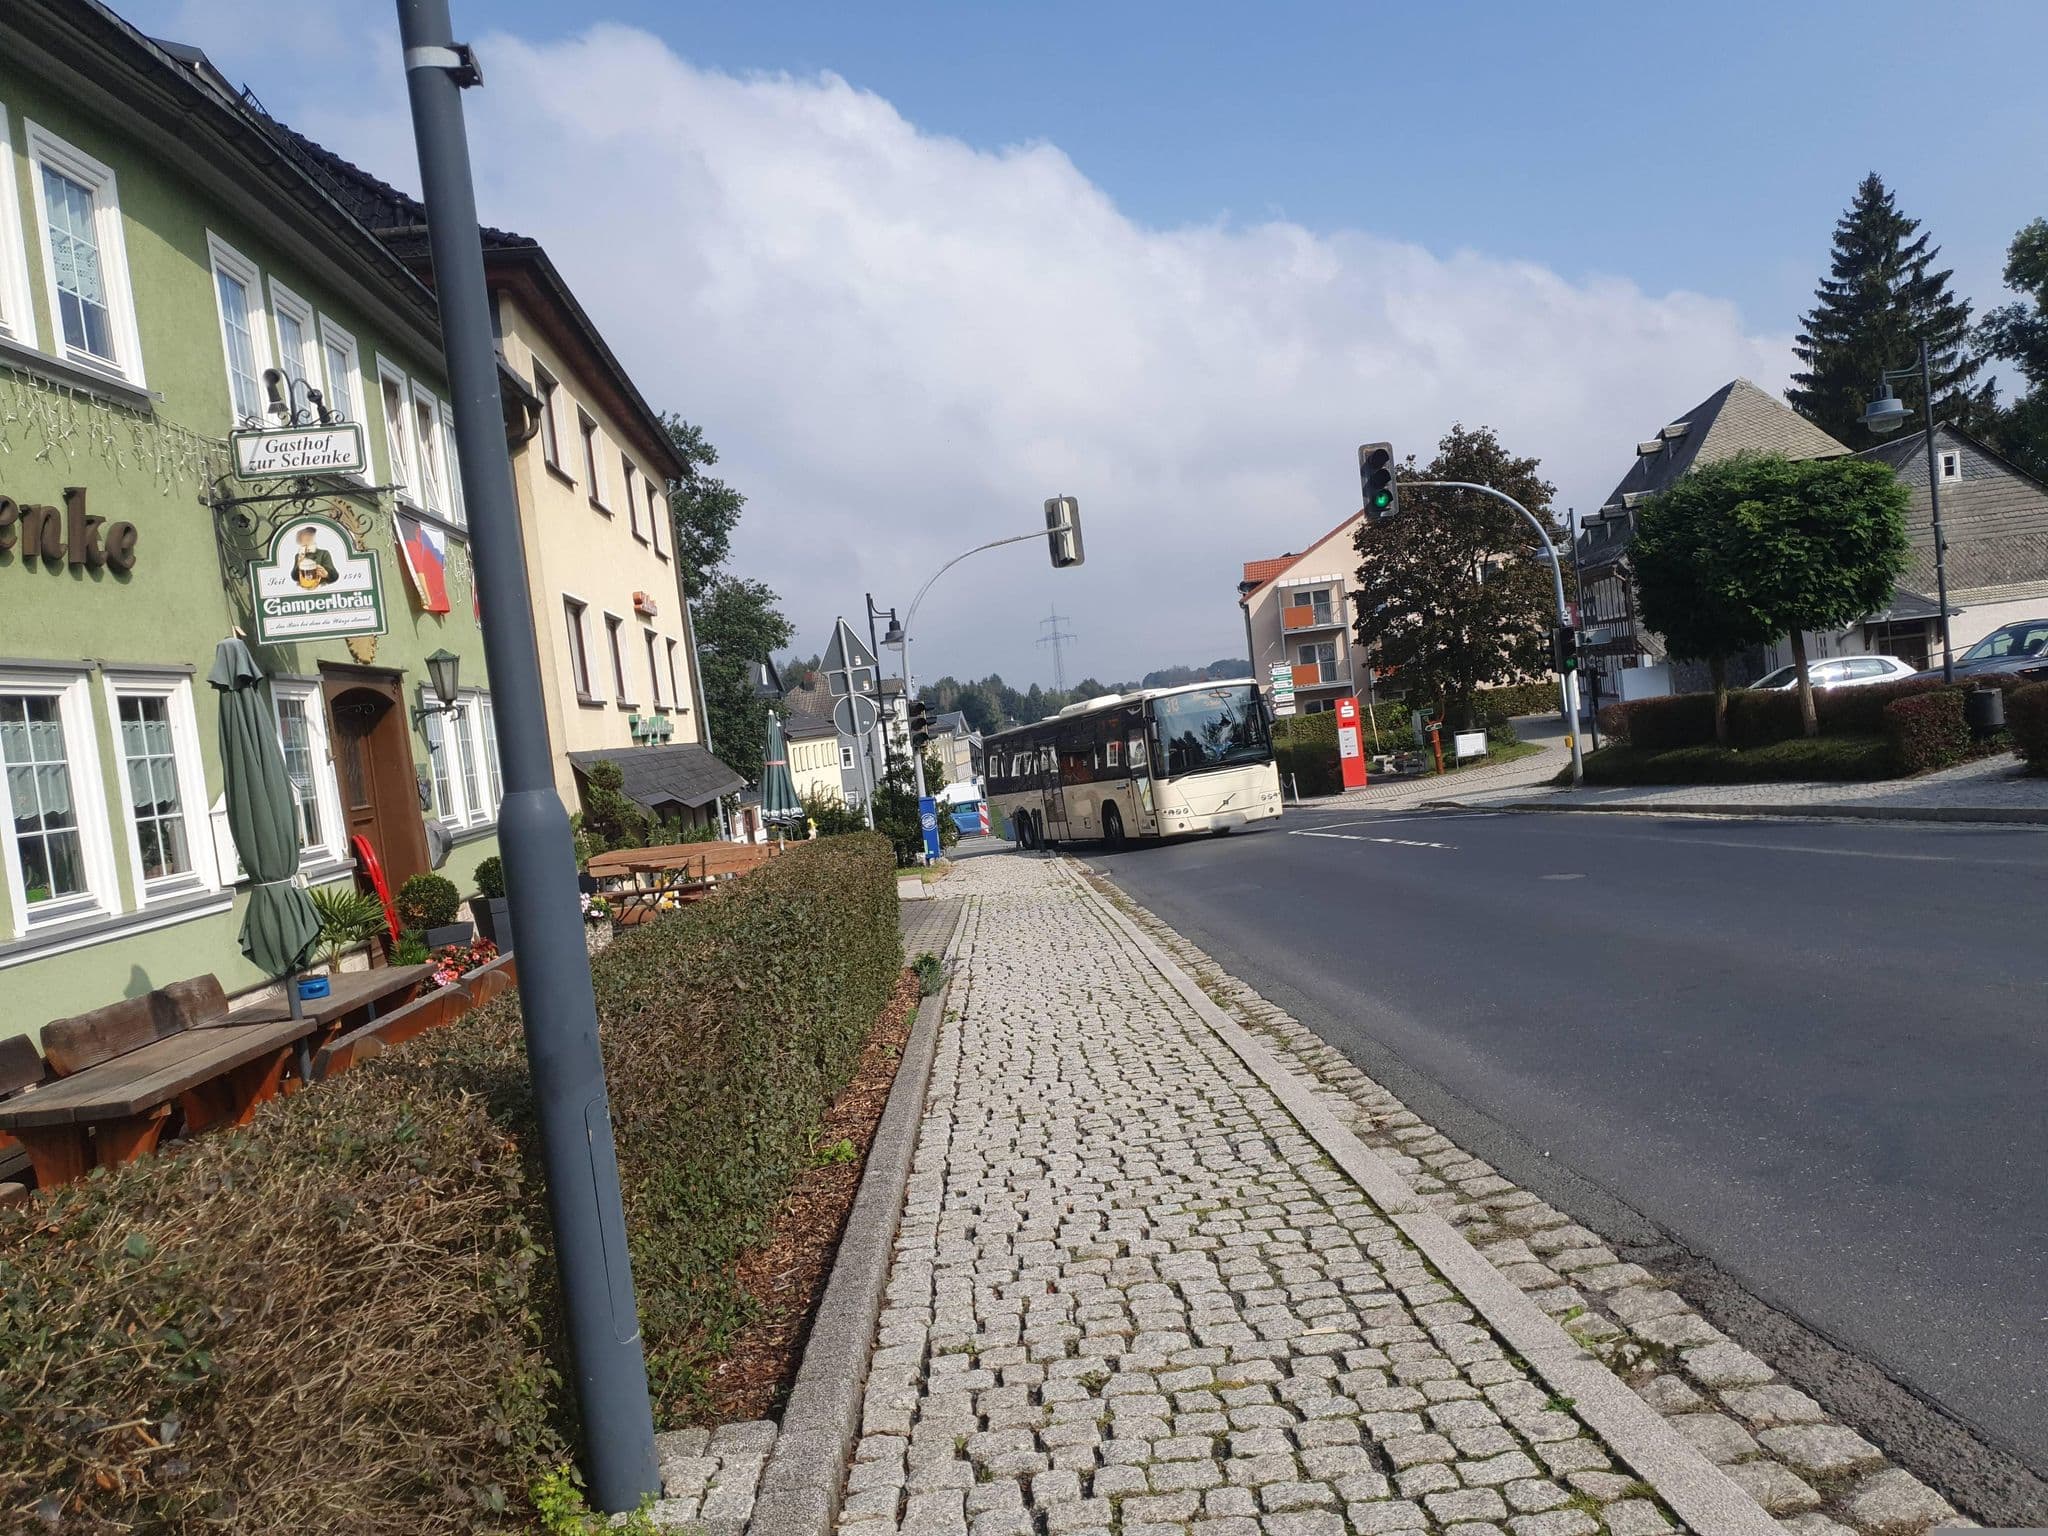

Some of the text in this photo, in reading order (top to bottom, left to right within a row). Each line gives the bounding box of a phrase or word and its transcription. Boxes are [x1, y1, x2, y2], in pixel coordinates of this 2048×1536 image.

[265, 436, 332, 453] Gasthof
[248, 450, 351, 471] zur Schenke
[267, 577, 286, 586] Seit
[263, 592, 373, 616] Gamperlbräu
